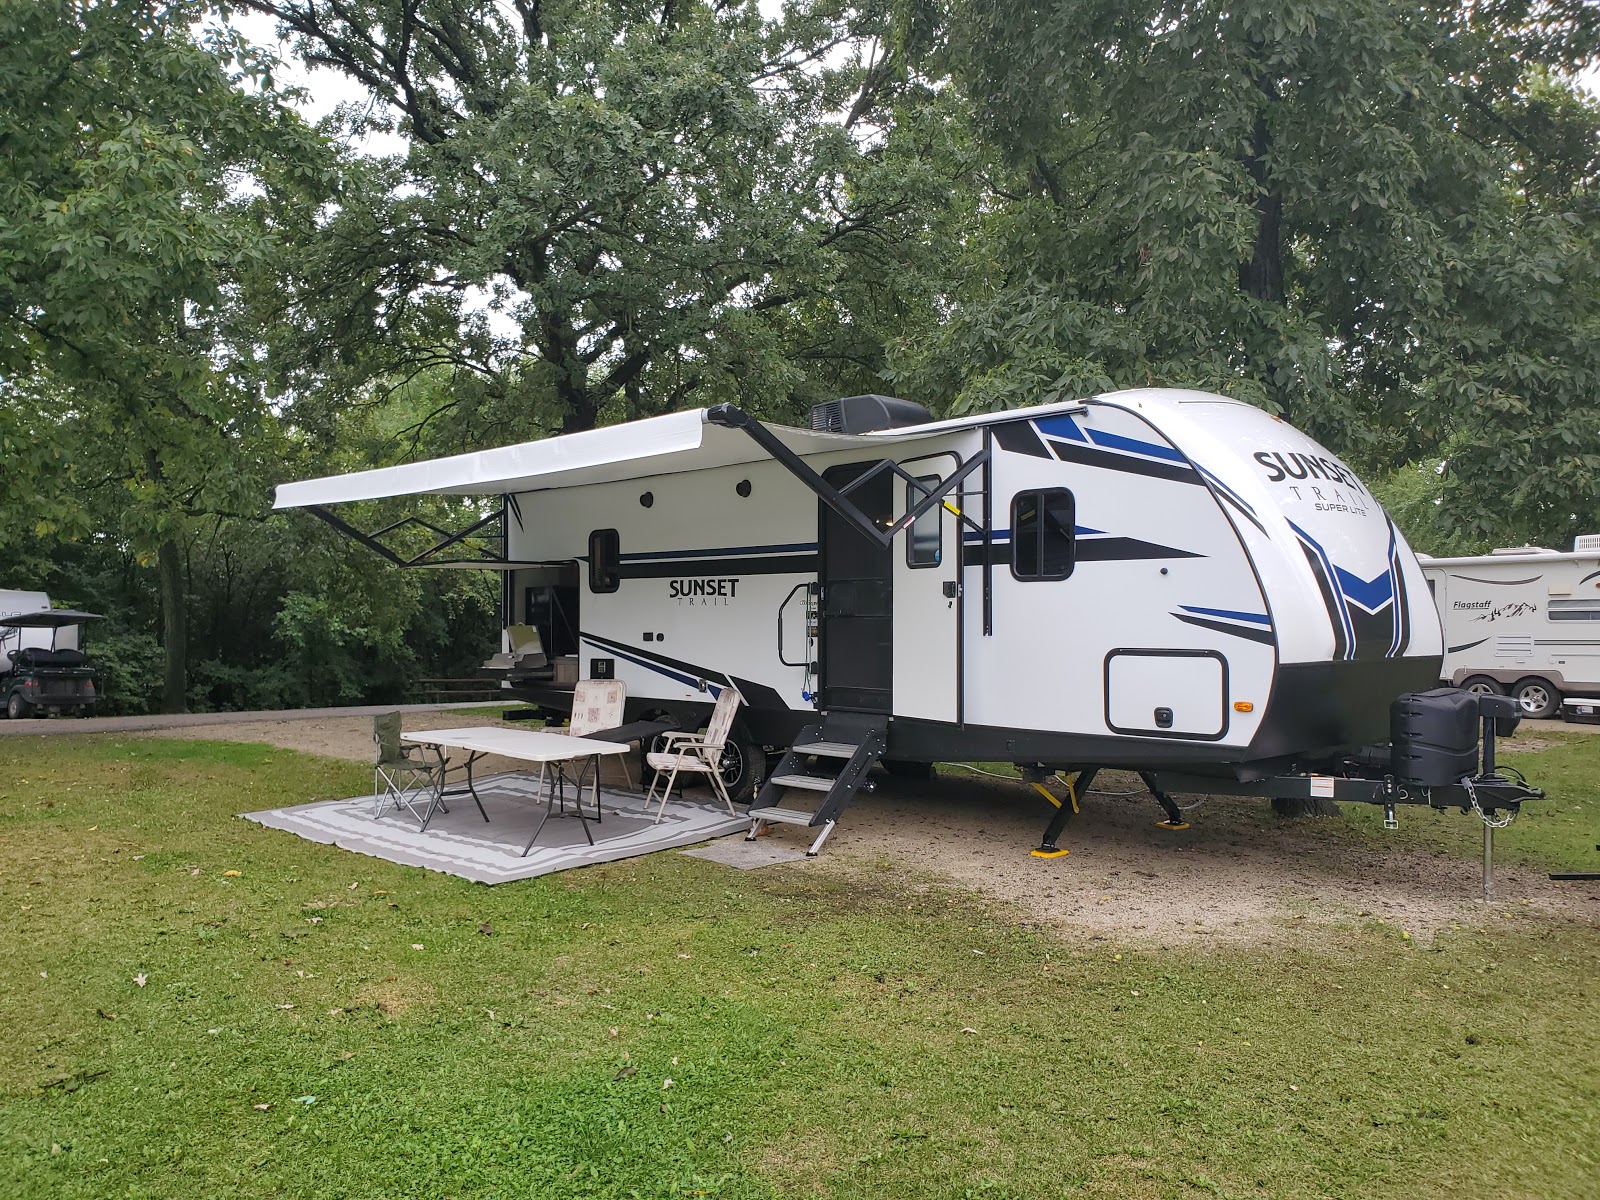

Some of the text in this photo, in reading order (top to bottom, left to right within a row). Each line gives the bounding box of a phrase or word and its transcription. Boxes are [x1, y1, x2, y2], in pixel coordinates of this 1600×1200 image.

[1253, 452, 1366, 496] SUNSET
[1290, 486, 1369, 510] TRAIL
[1314, 503, 1367, 517] SUPER LITE
[669, 579, 739, 598] SUNSET
[678, 597, 729, 606] TRAIL
[1453, 600, 1492, 610] Flagstaff
